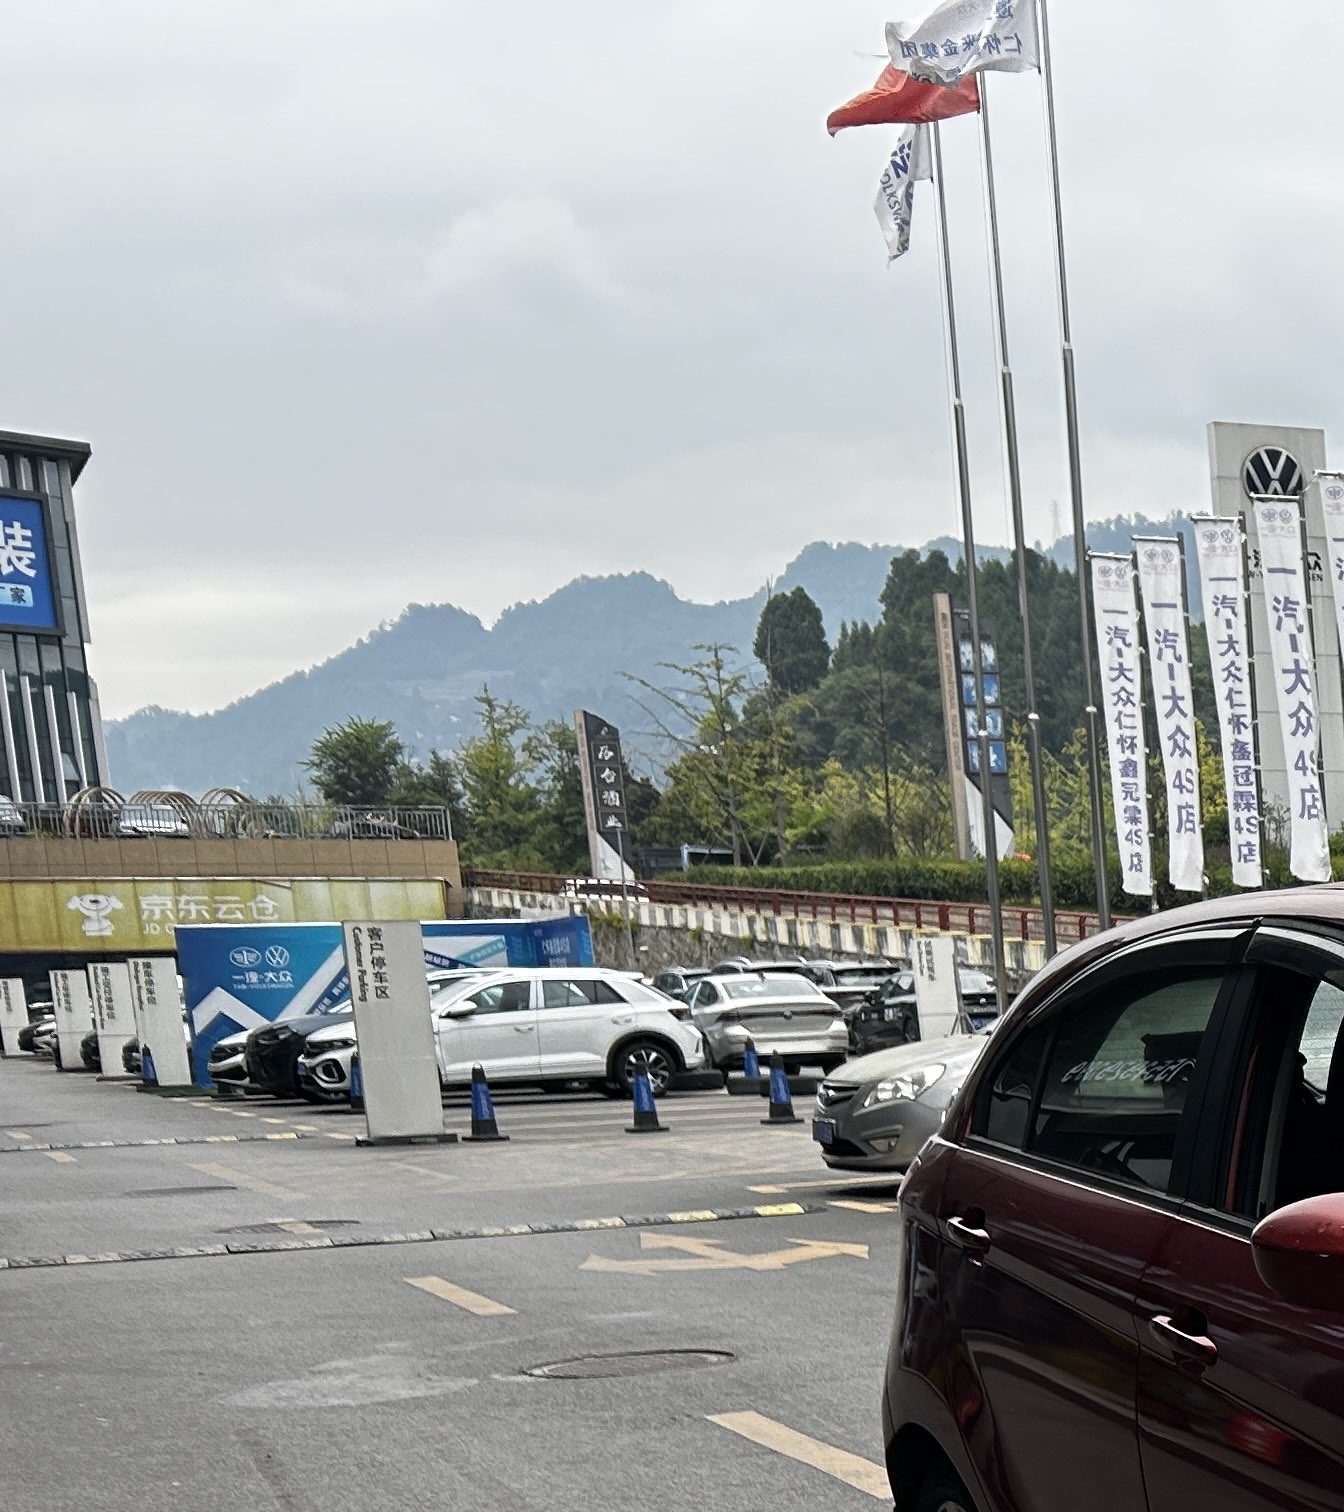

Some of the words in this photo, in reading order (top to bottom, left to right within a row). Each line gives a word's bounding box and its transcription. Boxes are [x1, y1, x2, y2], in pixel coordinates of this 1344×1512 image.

[139, 894, 280, 921] 京东云仓
[367, 926, 390, 999] 客户停车区
